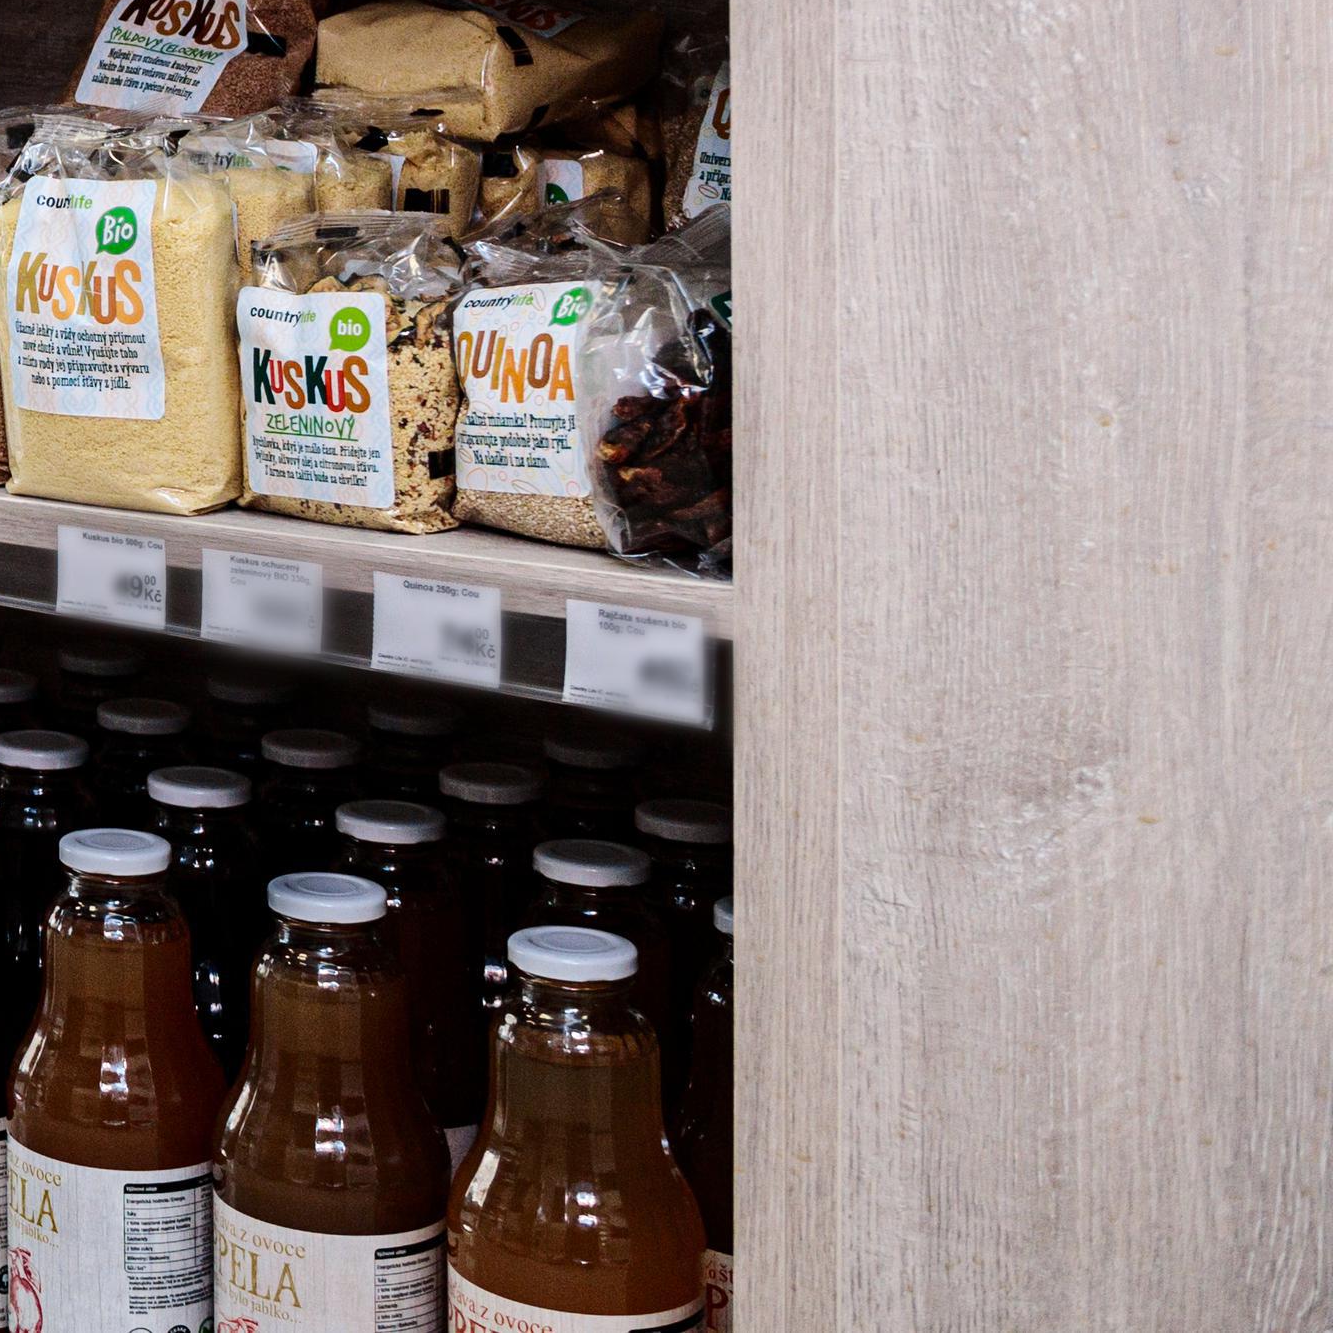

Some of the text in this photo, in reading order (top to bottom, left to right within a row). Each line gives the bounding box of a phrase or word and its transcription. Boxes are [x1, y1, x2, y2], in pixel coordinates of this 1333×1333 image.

[102, 215, 135, 246] Bio
[15, 251, 145, 326] KUSKUS
[464, 294, 534, 312] countrylife
[249, 305, 316, 327] countrylife
[336, 318, 364, 337] bio
[77, 329, 107, 347] ochotný
[108, 330, 146, 346] přijmout
[84, 345, 119, 361] Využijte
[120, 348, 139, 359] toho
[67, 359, 113, 375] připravujte
[120, 362, 150, 375] vývaru
[456, 329, 576, 405] QUINOA
[52, 374, 81, 390] pomocí
[110, 376, 131, 391] jídla.
[252, 347, 371, 415] KUSKUS
[265, 413, 356, 440] ZELENINOVÝ
[82, 531, 163, 551] Kuskus bio Cou
[144, 588, 163, 604] Kč
[403, 579, 434, 594] Quinoa
[461, 586, 480, 600] Cou
[598, 608, 633, 625] Rajčata
[22, 1163, 63, 1188] ovoce
[252, 1234, 307, 1261] ovoce
